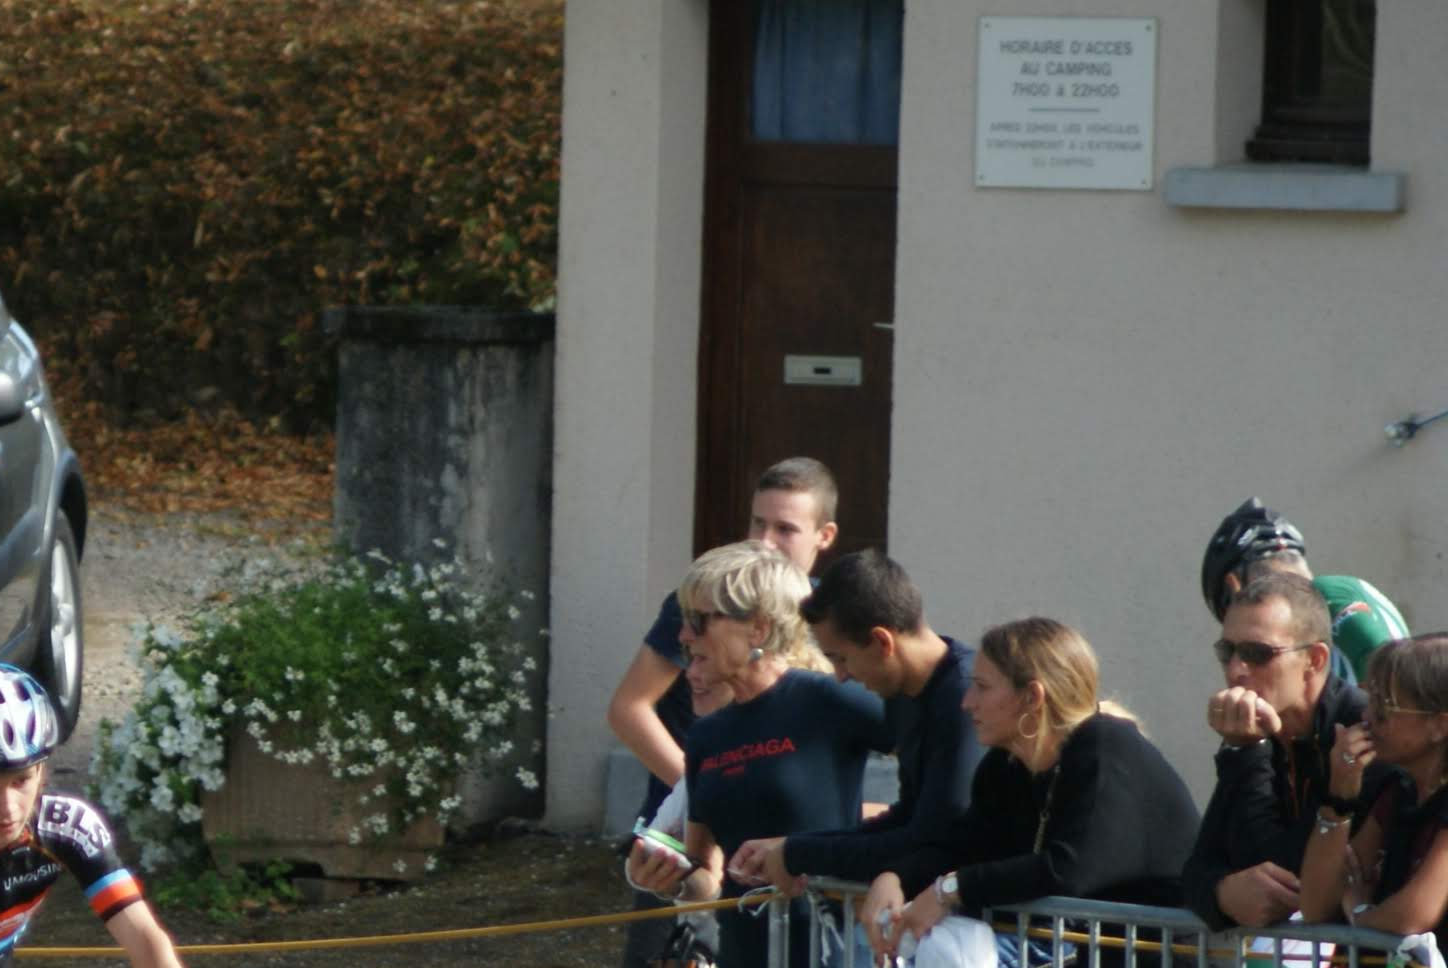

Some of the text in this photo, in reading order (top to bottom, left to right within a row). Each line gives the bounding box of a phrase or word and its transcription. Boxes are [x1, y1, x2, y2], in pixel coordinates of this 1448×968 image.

[999, 40, 1064, 55] HORAIRE
[1020, 62, 1113, 77] AU CAMPING
[1012, 82, 1051, 97] 7H00
[1071, 83, 1121, 97] 22H00
[45, 800, 105, 849] BLS
